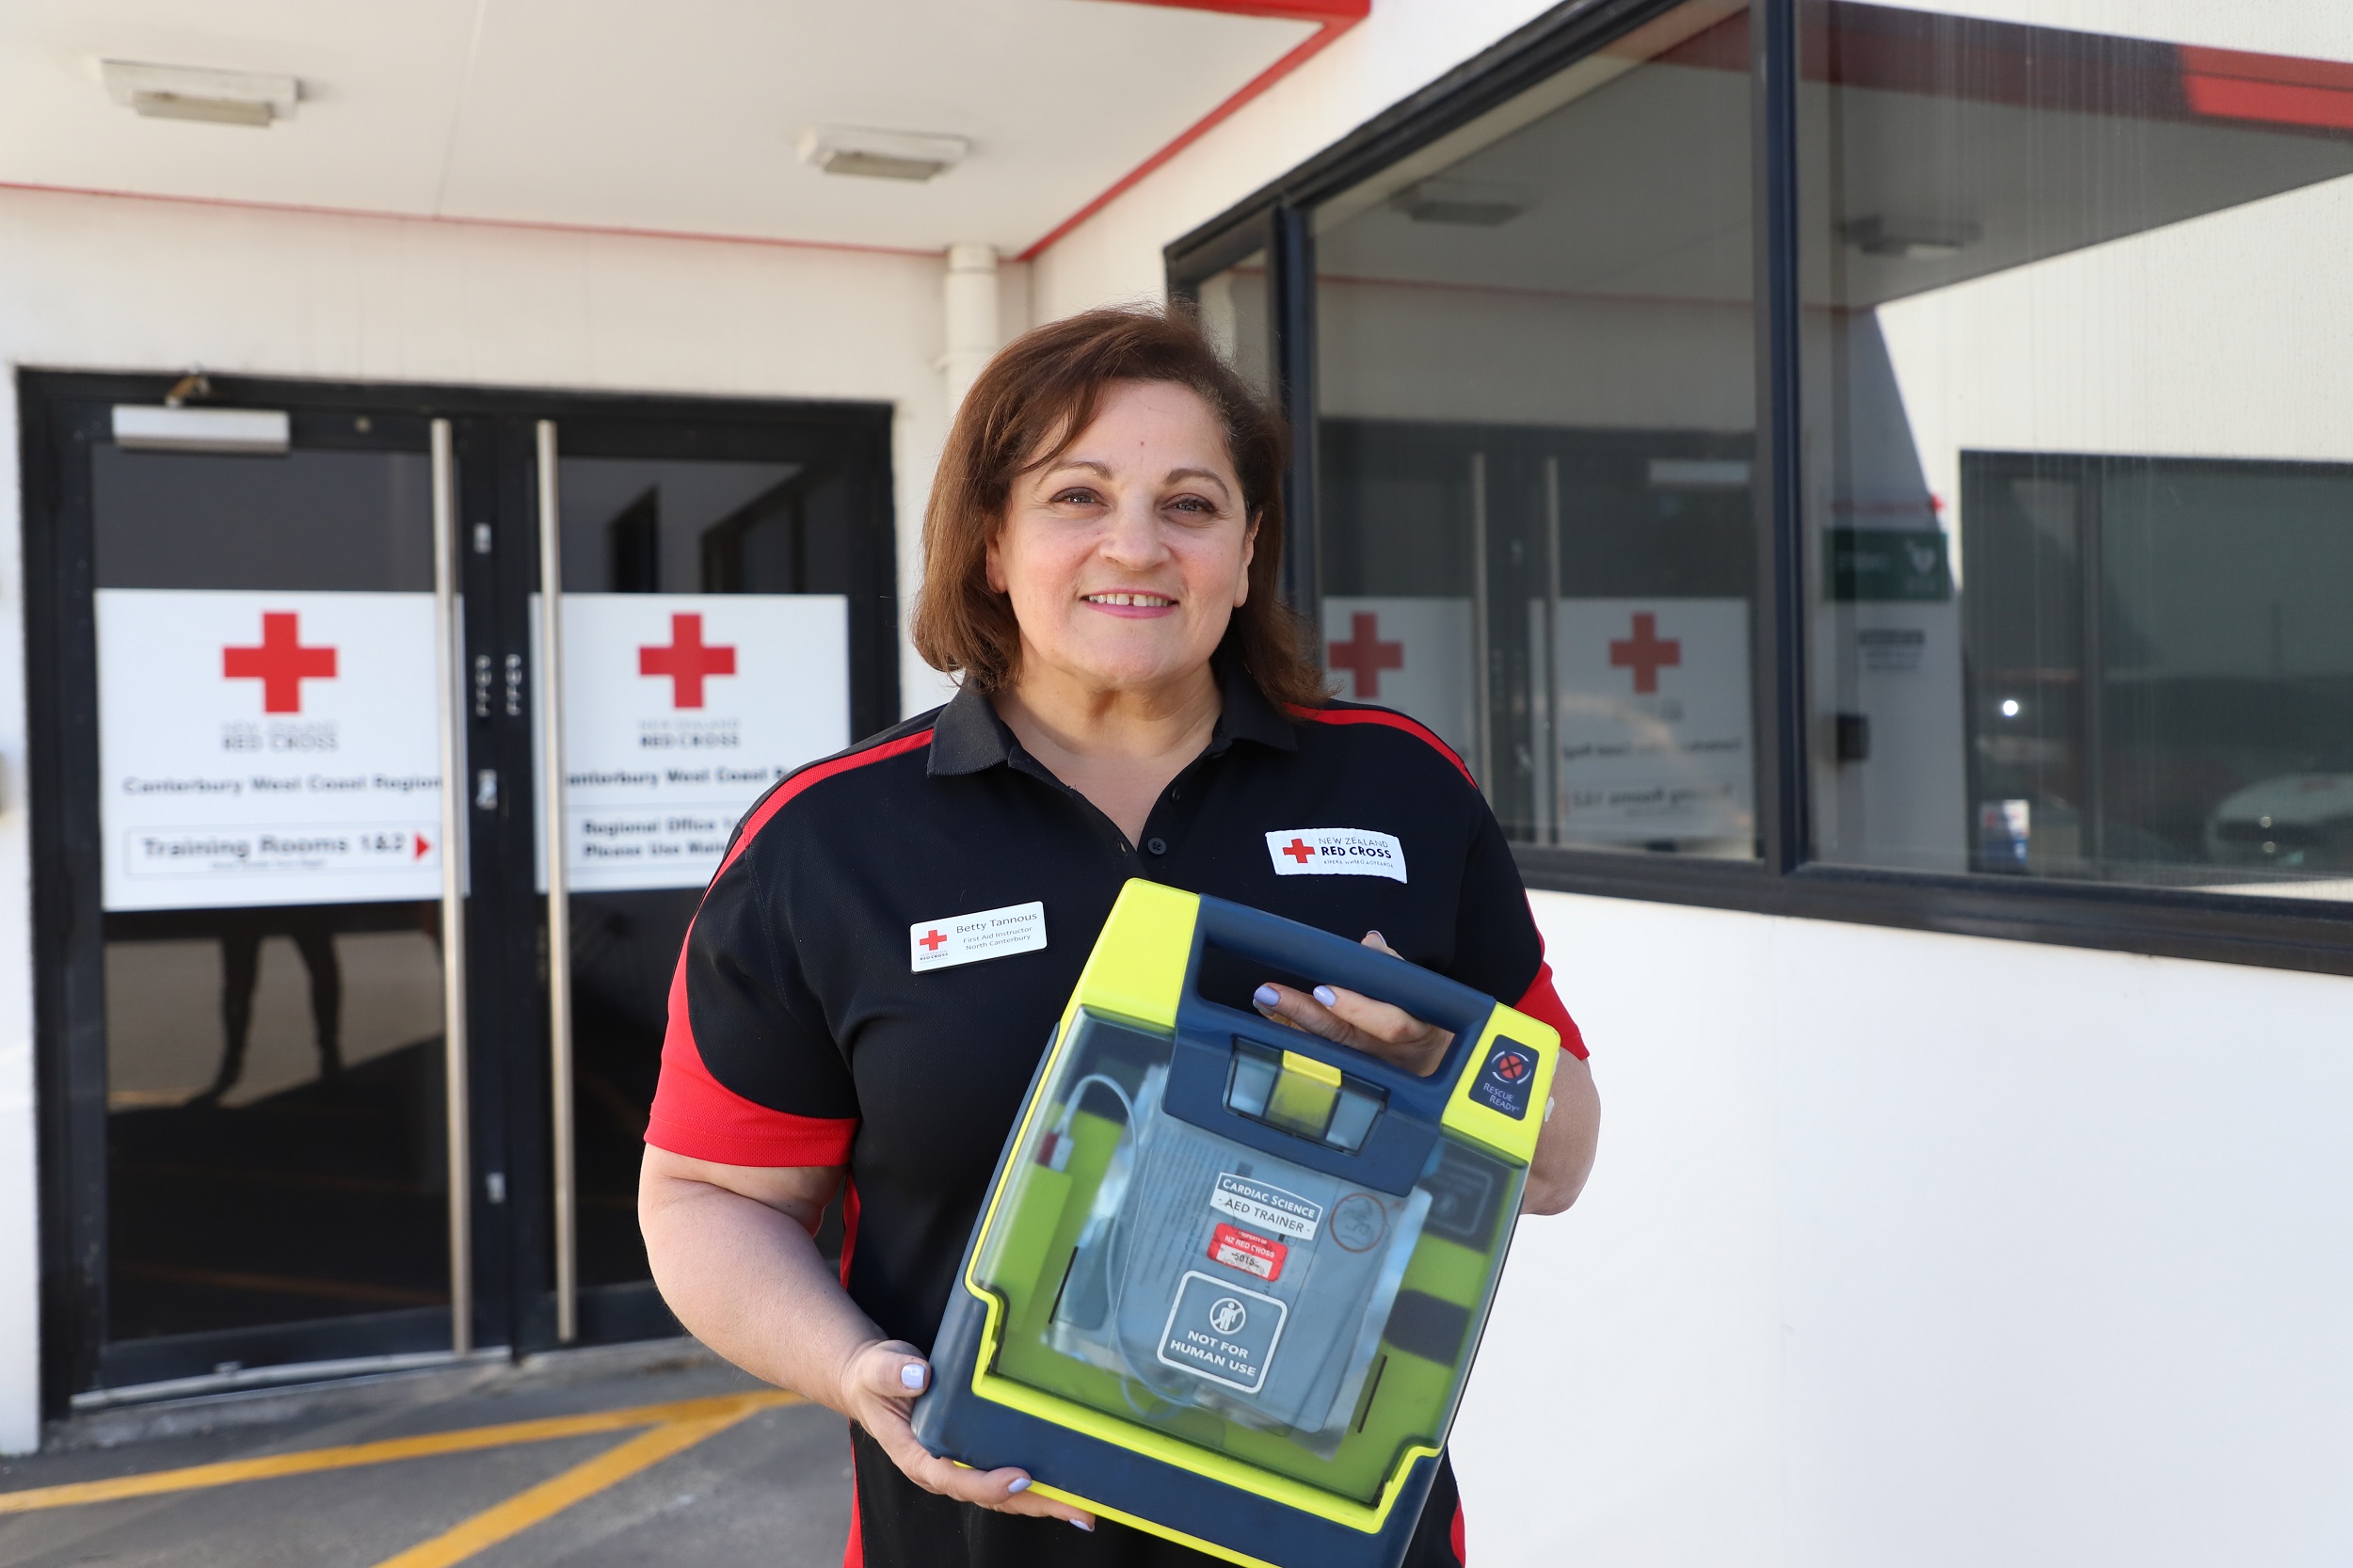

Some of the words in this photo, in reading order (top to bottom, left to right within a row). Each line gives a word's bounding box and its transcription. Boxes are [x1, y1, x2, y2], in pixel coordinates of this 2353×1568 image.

[222, 734, 264, 751] RED
[269, 733, 339, 751] CROSS
[640, 732, 673, 748] RED
[679, 731, 740, 747] CROSS
[123, 776, 243, 796] Canterbury
[250, 776, 301, 793] West
[307, 774, 367, 792] Coast
[374, 773, 442, 794] Region
[566, 770, 659, 789] anterbury
[666, 768, 711, 783] West
[715, 766, 768, 782] Coast
[584, 819, 660, 836] Regional
[667, 819, 715, 832] Office
[142, 836, 250, 862] Training
[260, 834, 349, 855] Rooms
[360, 832, 407, 854] 1&2
[584, 842, 641, 857] Please
[650, 841, 679, 856] Use
[1321, 846, 1346, 856] RED
[1350, 846, 1392, 858] CROSS
[1345, 837, 1388, 847] ZEALAND
[956, 922, 987, 934] Betty
[989, 913, 1037, 927] Tannous
[963, 935, 980, 944] First
[982, 932, 995, 941] Aid
[995, 926, 1032, 938] Instructor
[966, 942, 988, 951] North
[989, 934, 1031, 947] Canterbury
[1483, 1082, 1514, 1102] RESCUE
[1223, 1178, 1270, 1204] CARDIAC
[1271, 1194, 1316, 1218] SCIENCE
[1225, 1198, 1250, 1214] AED
[1254, 1208, 1305, 1233] TRAINER
[1225, 1235, 1235, 1243] NZ
[1235, 1239, 1251, 1248] RED
[1251, 1244, 1275, 1257] CROSS
[1187, 1330, 1220, 1348] NOT
[1220, 1341, 1249, 1359] FOR
[1170, 1339, 1226, 1367] HUMAN
[1228, 1361, 1257, 1378] USE
